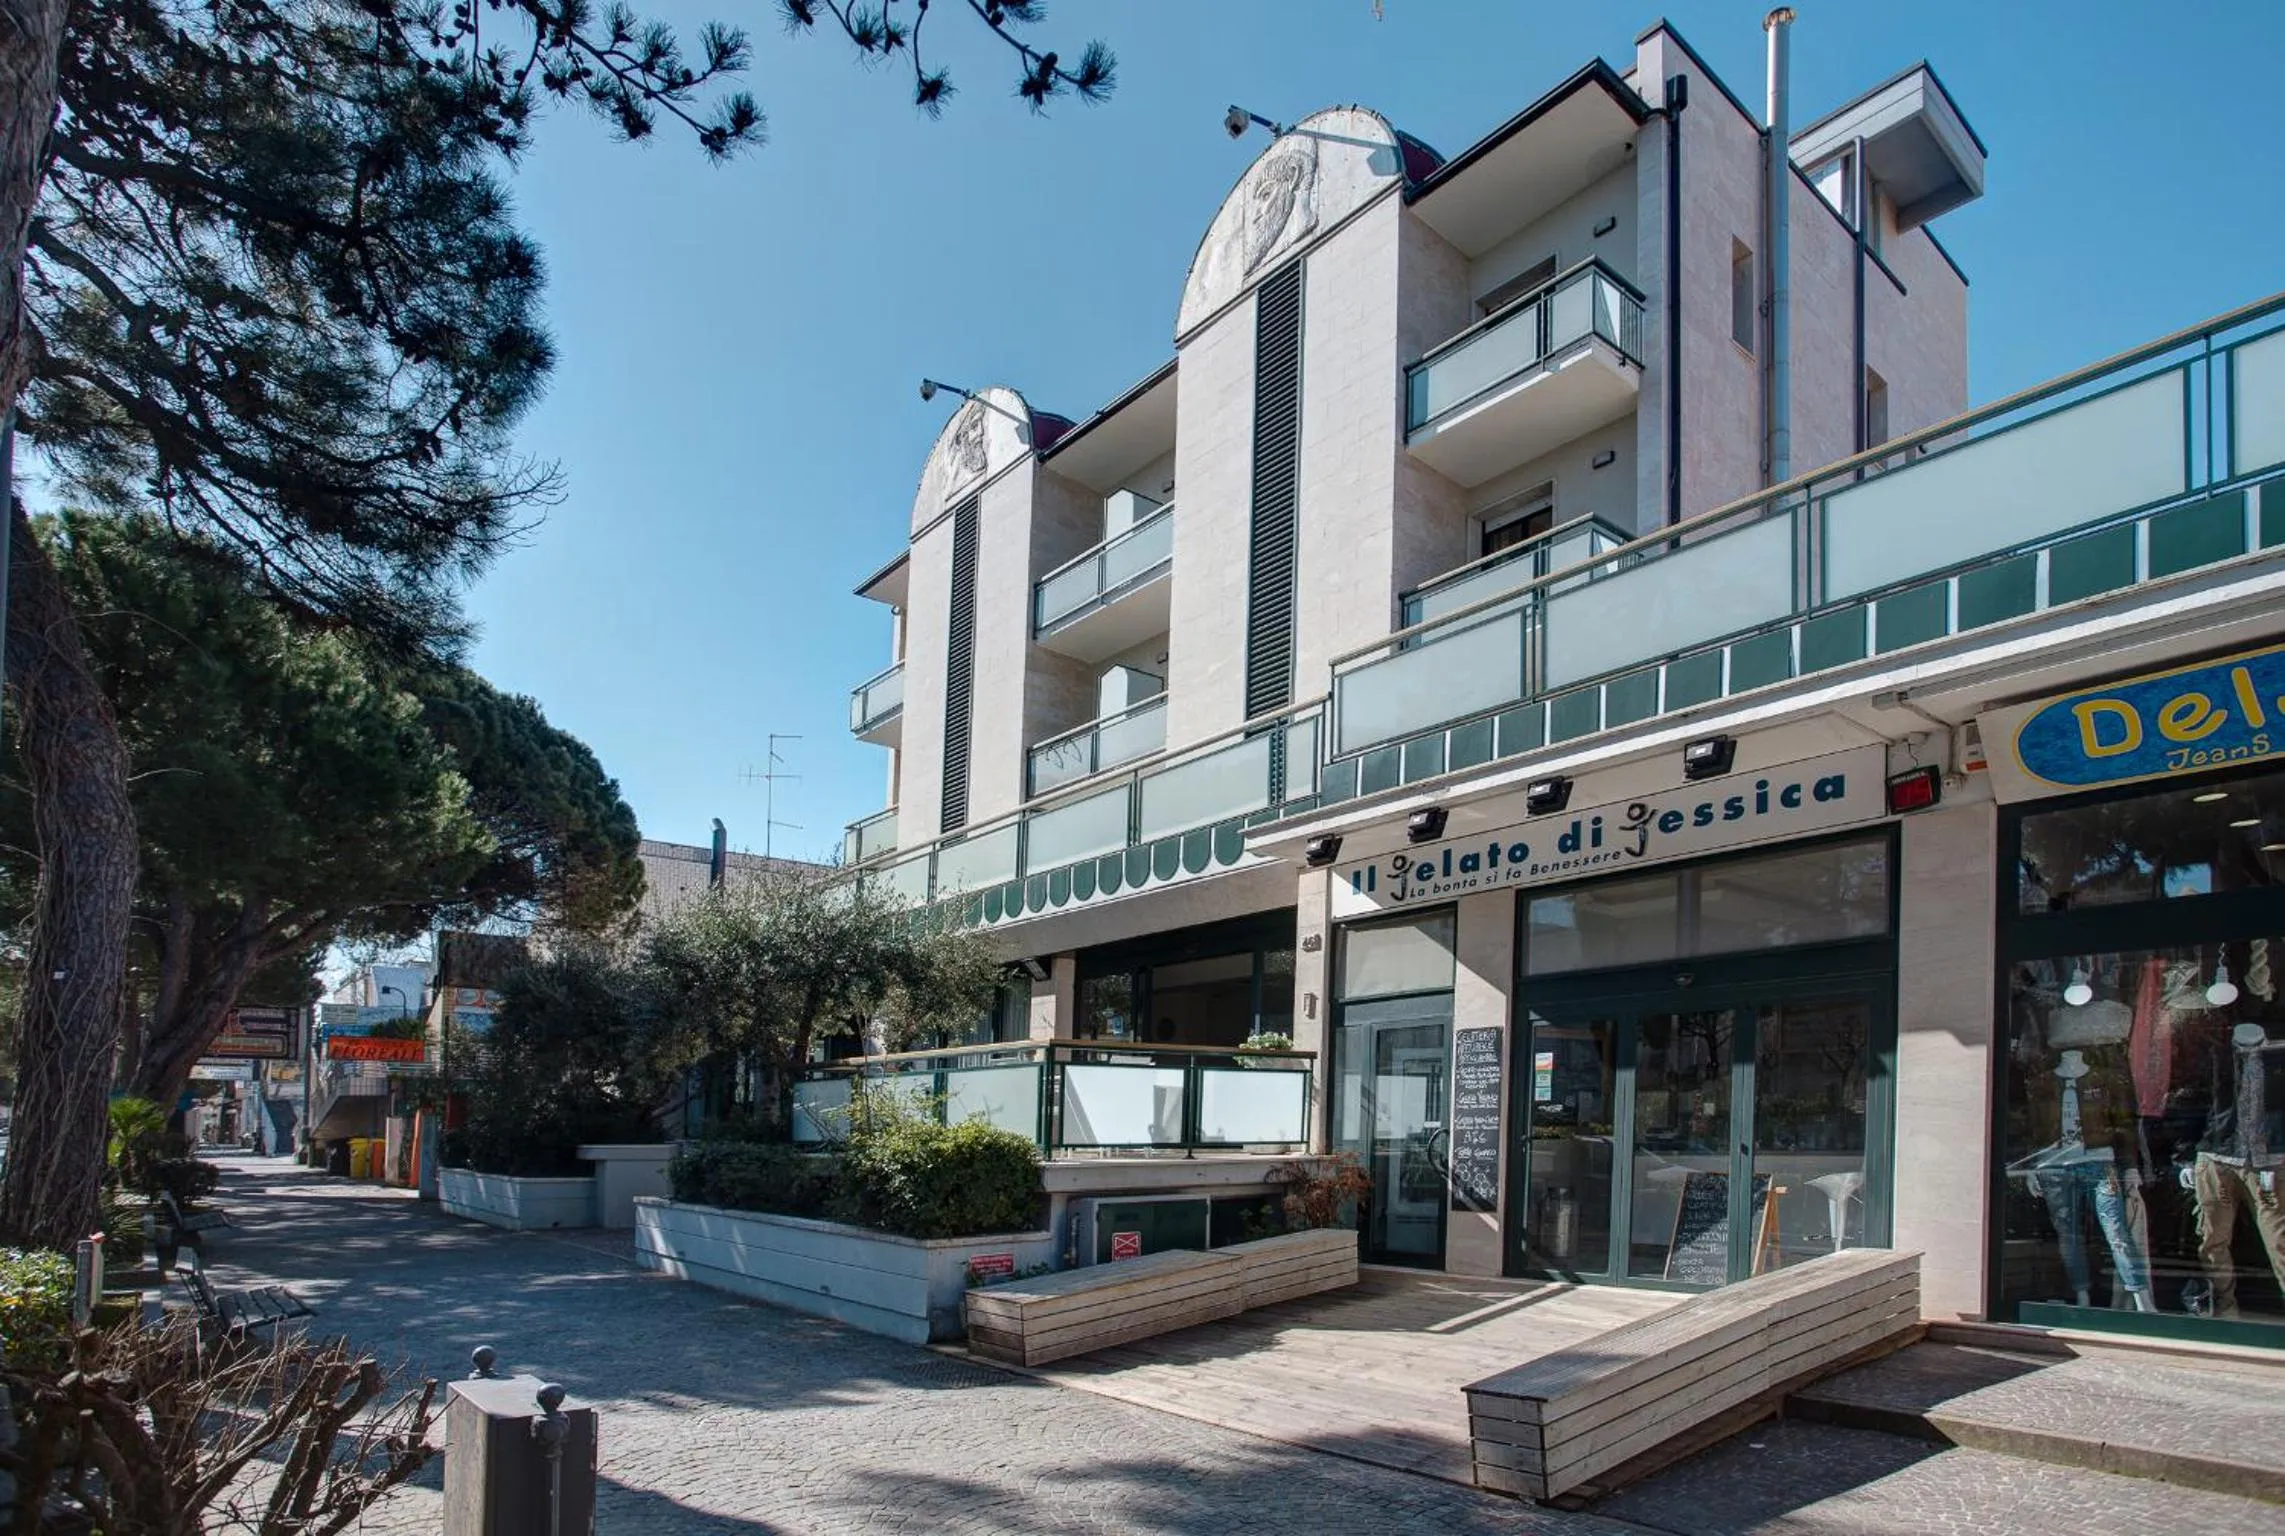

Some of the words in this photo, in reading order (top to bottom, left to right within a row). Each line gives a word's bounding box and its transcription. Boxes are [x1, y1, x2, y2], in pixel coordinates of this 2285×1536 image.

[2072, 667, 2285, 758] Del
[1352, 865, 1376, 896] Il
[1558, 816, 1602, 854] di
[1506, 867, 1522, 881] fa
[1530, 850, 1621, 876] Benessere
